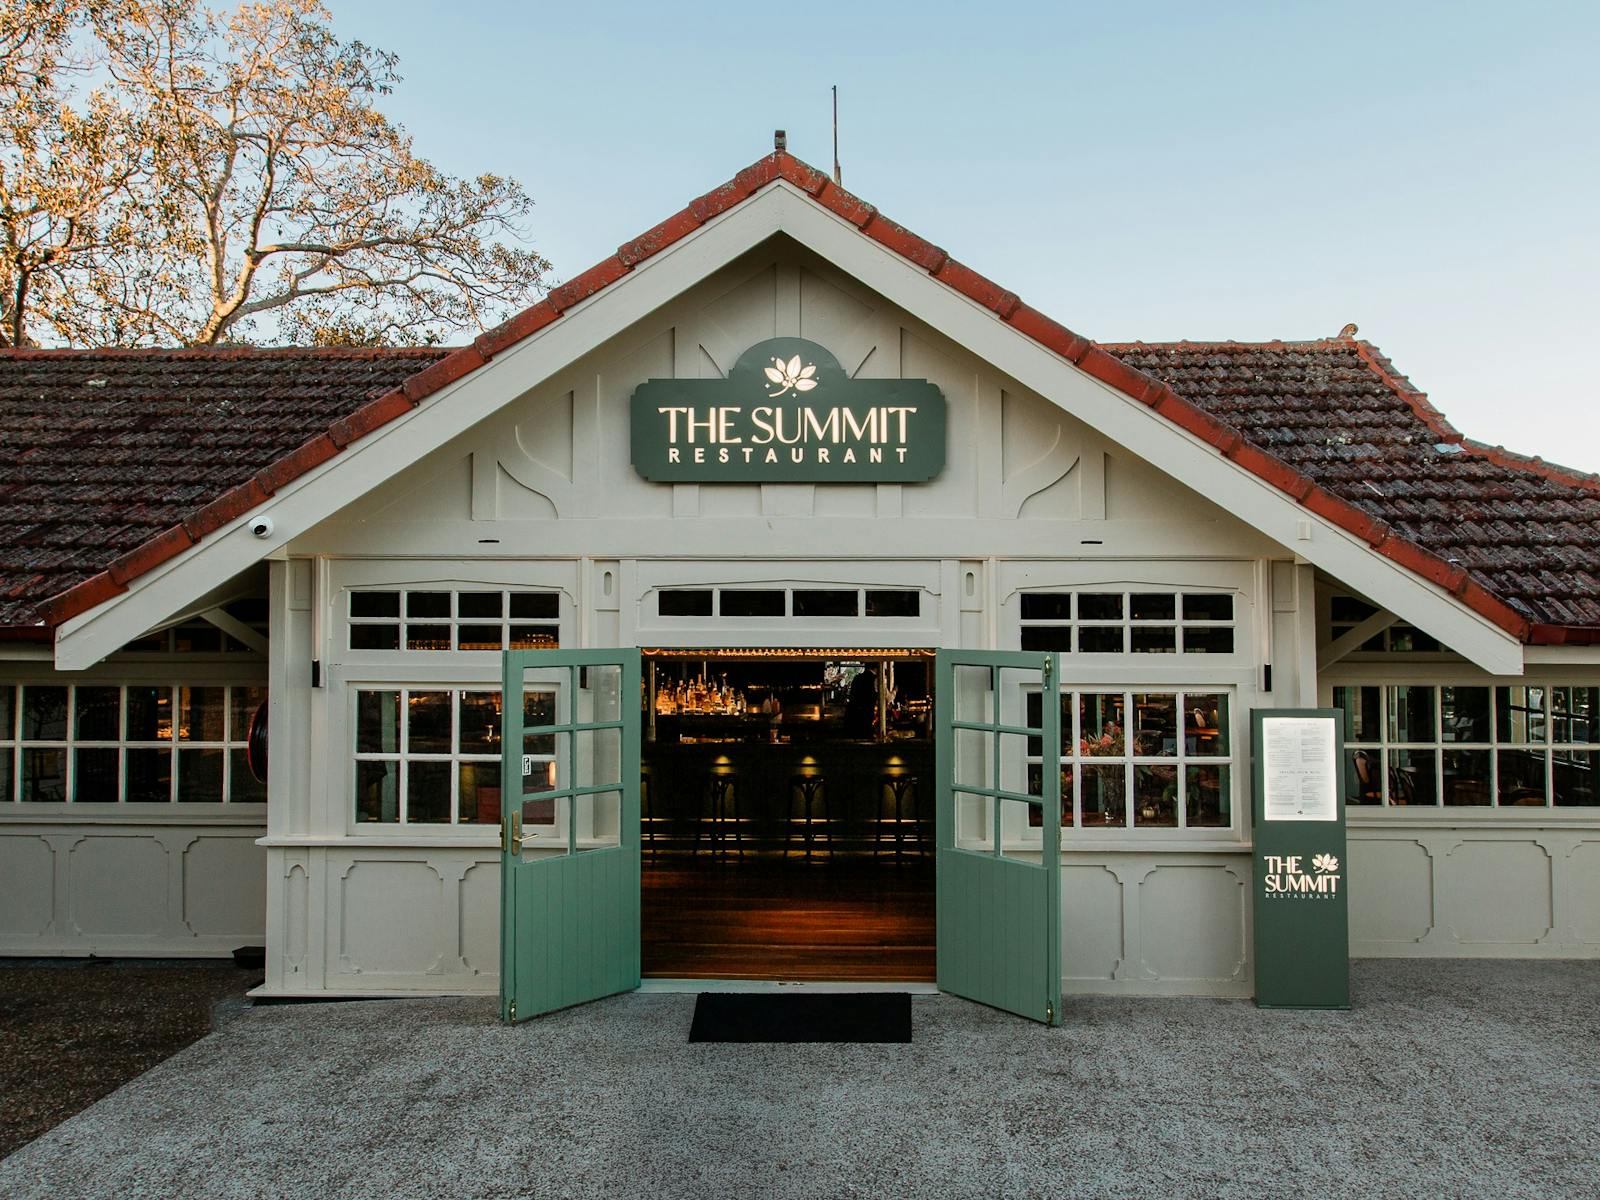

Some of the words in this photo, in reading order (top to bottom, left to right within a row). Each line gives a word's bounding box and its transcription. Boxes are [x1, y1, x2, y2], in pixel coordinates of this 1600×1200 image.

[657, 407, 742, 443] THE
[751, 406, 917, 444] SUMMIT
[668, 447, 908, 463] RESTAURANT
[1263, 855, 1304, 874] THE
[1264, 874, 1341, 893] SUMMIT
